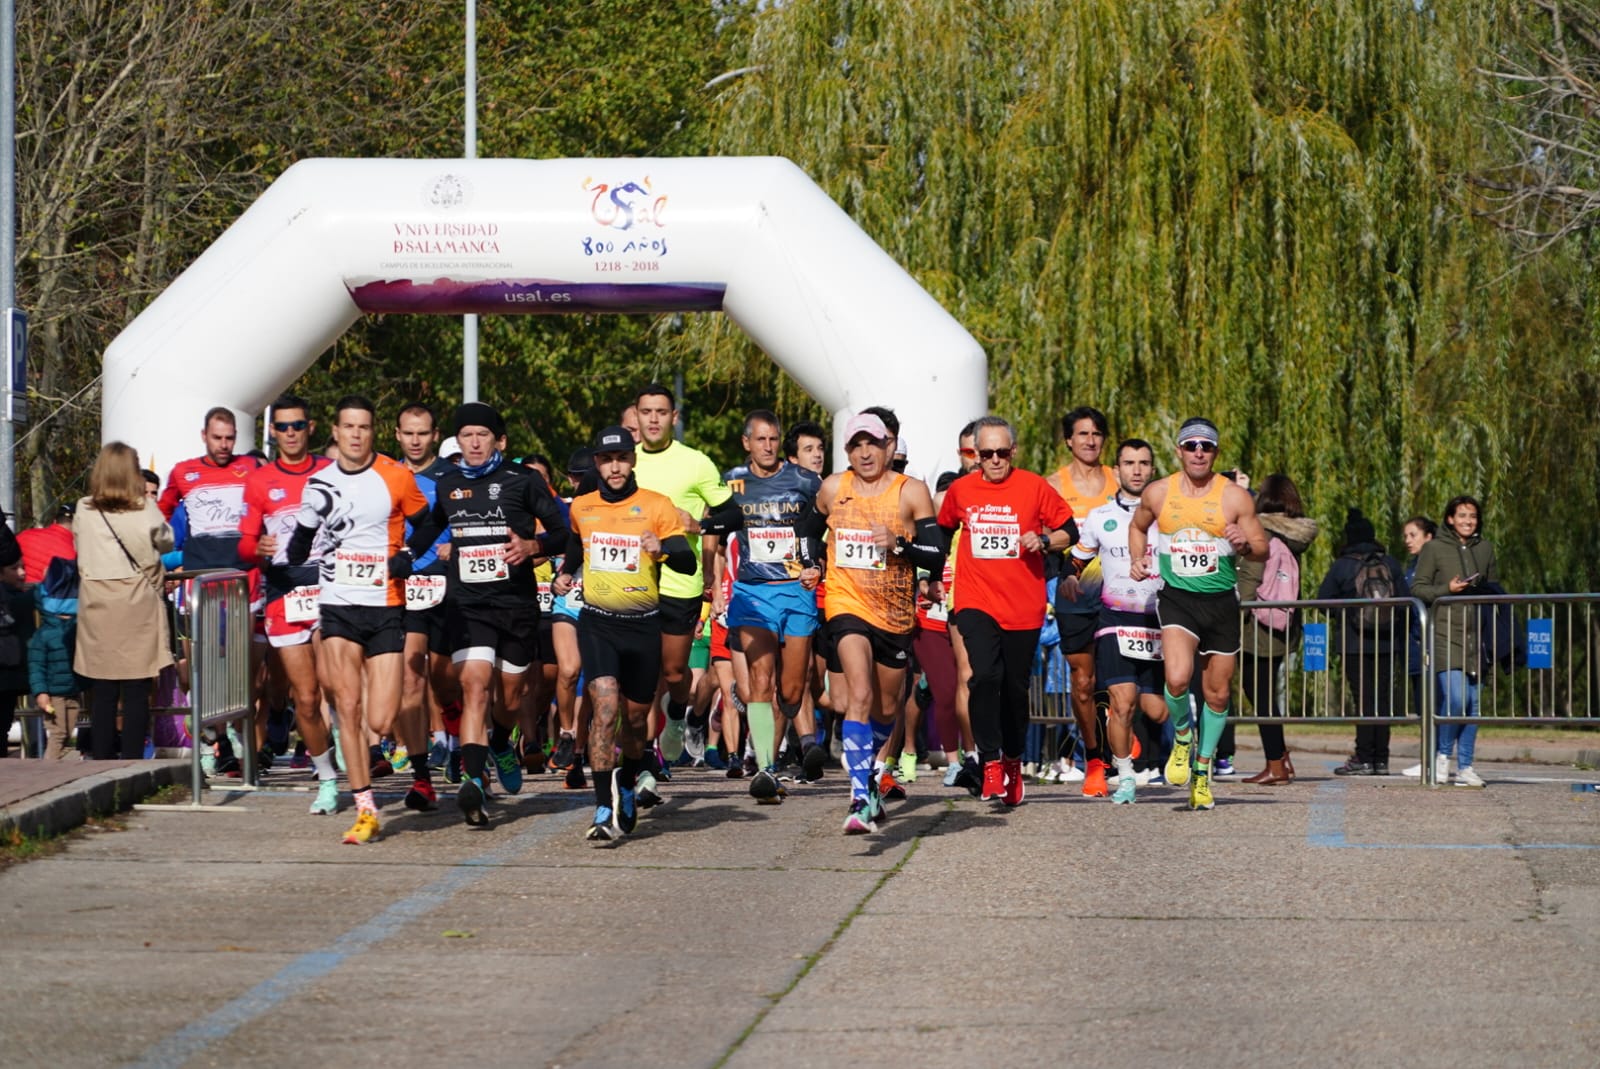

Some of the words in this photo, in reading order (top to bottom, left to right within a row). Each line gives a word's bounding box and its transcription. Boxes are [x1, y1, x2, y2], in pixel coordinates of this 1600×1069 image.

[581, 236, 614, 257] 800
[622, 236, 668, 257] AÑOS
[380, 262, 409, 270] CAMPUS
[594, 261, 622, 272] 1218
[632, 261, 660, 272] 2018
[504, 289, 572, 303] usal.es
[14, 319, 25, 384] P
[740, 501, 800, 516] OLISEUM
[749, 530, 794, 539] bedunia
[972, 525, 1019, 535] bedunia
[592, 534, 639, 549] bedunia
[837, 532, 875, 543] bedun
[981, 536, 1009, 550] 253
[767, 540, 776, 554] 9
[845, 544, 874, 560] 311
[336, 552, 385, 563] bedunia
[600, 547, 627, 563] 191
[1180, 554, 1209, 568] 198
[347, 563, 376, 578] 127
[468, 558, 497, 574] 258
[407, 588, 433, 601] 341
[1127, 639, 1154, 653] 230
